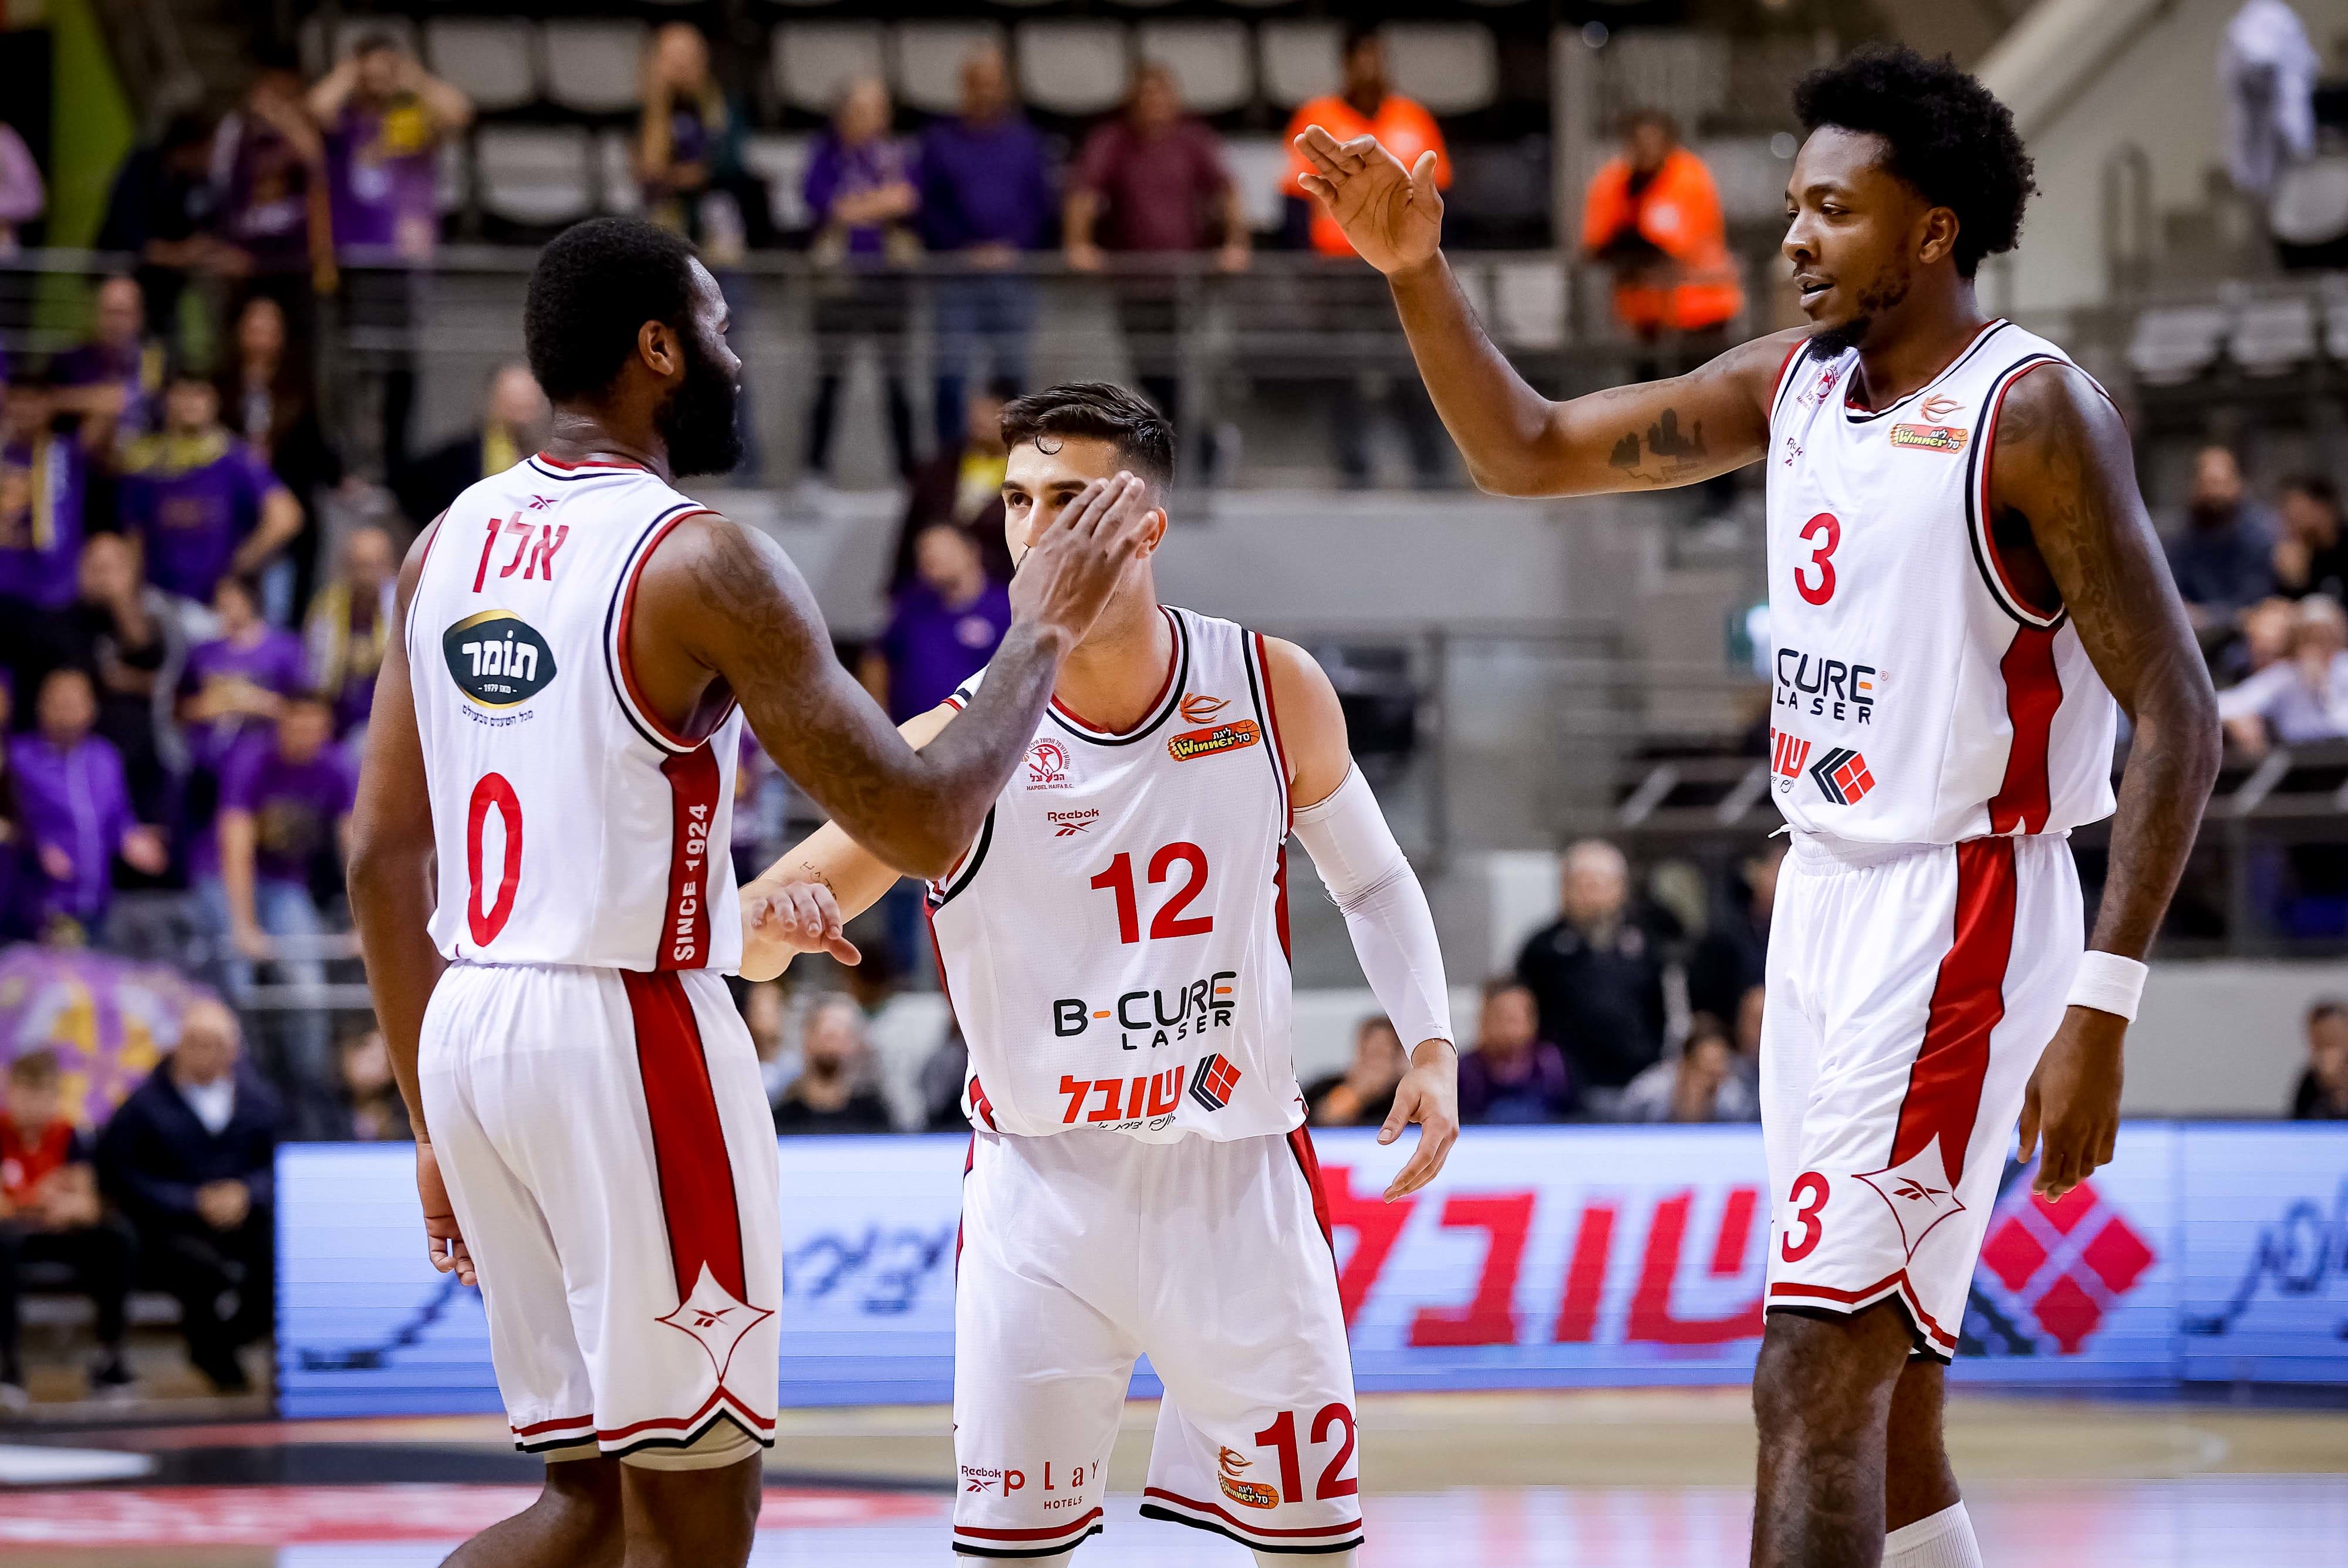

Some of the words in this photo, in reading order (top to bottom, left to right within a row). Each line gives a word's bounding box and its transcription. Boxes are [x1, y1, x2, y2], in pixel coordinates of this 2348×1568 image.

[1898, 430, 1946, 446] Winner
[1948, 438, 1960, 449] סל
[473, 511, 568, 593] אלן
[1794, 513, 1840, 606] 3
[483, 684, 498, 692] 1979
[1777, 687, 1871, 725] LASER
[1176, 736, 1235, 755] Winner
[1235, 733, 1250, 742] סל
[1213, 727, 1231, 739] ליגת
[1047, 808, 1099, 822] Reebok
[467, 772, 522, 947] 0
[673, 881, 697, 962] SINCE
[686, 804, 708, 871] 1924
[1090, 842, 1213, 944] 12
[1053, 971, 1237, 1037] B-CURE
[1122, 1009, 1231, 1050] LASER
[1059, 1065, 1185, 1124] שובל
[1782, 1171, 1830, 1263] 3
[962, 1465, 1001, 1478] Reebok
[1254, 1403, 1358, 1503] 12
[1044, 1496, 1082, 1510] HOTELS
[1256, 1492, 1268, 1503] סל
